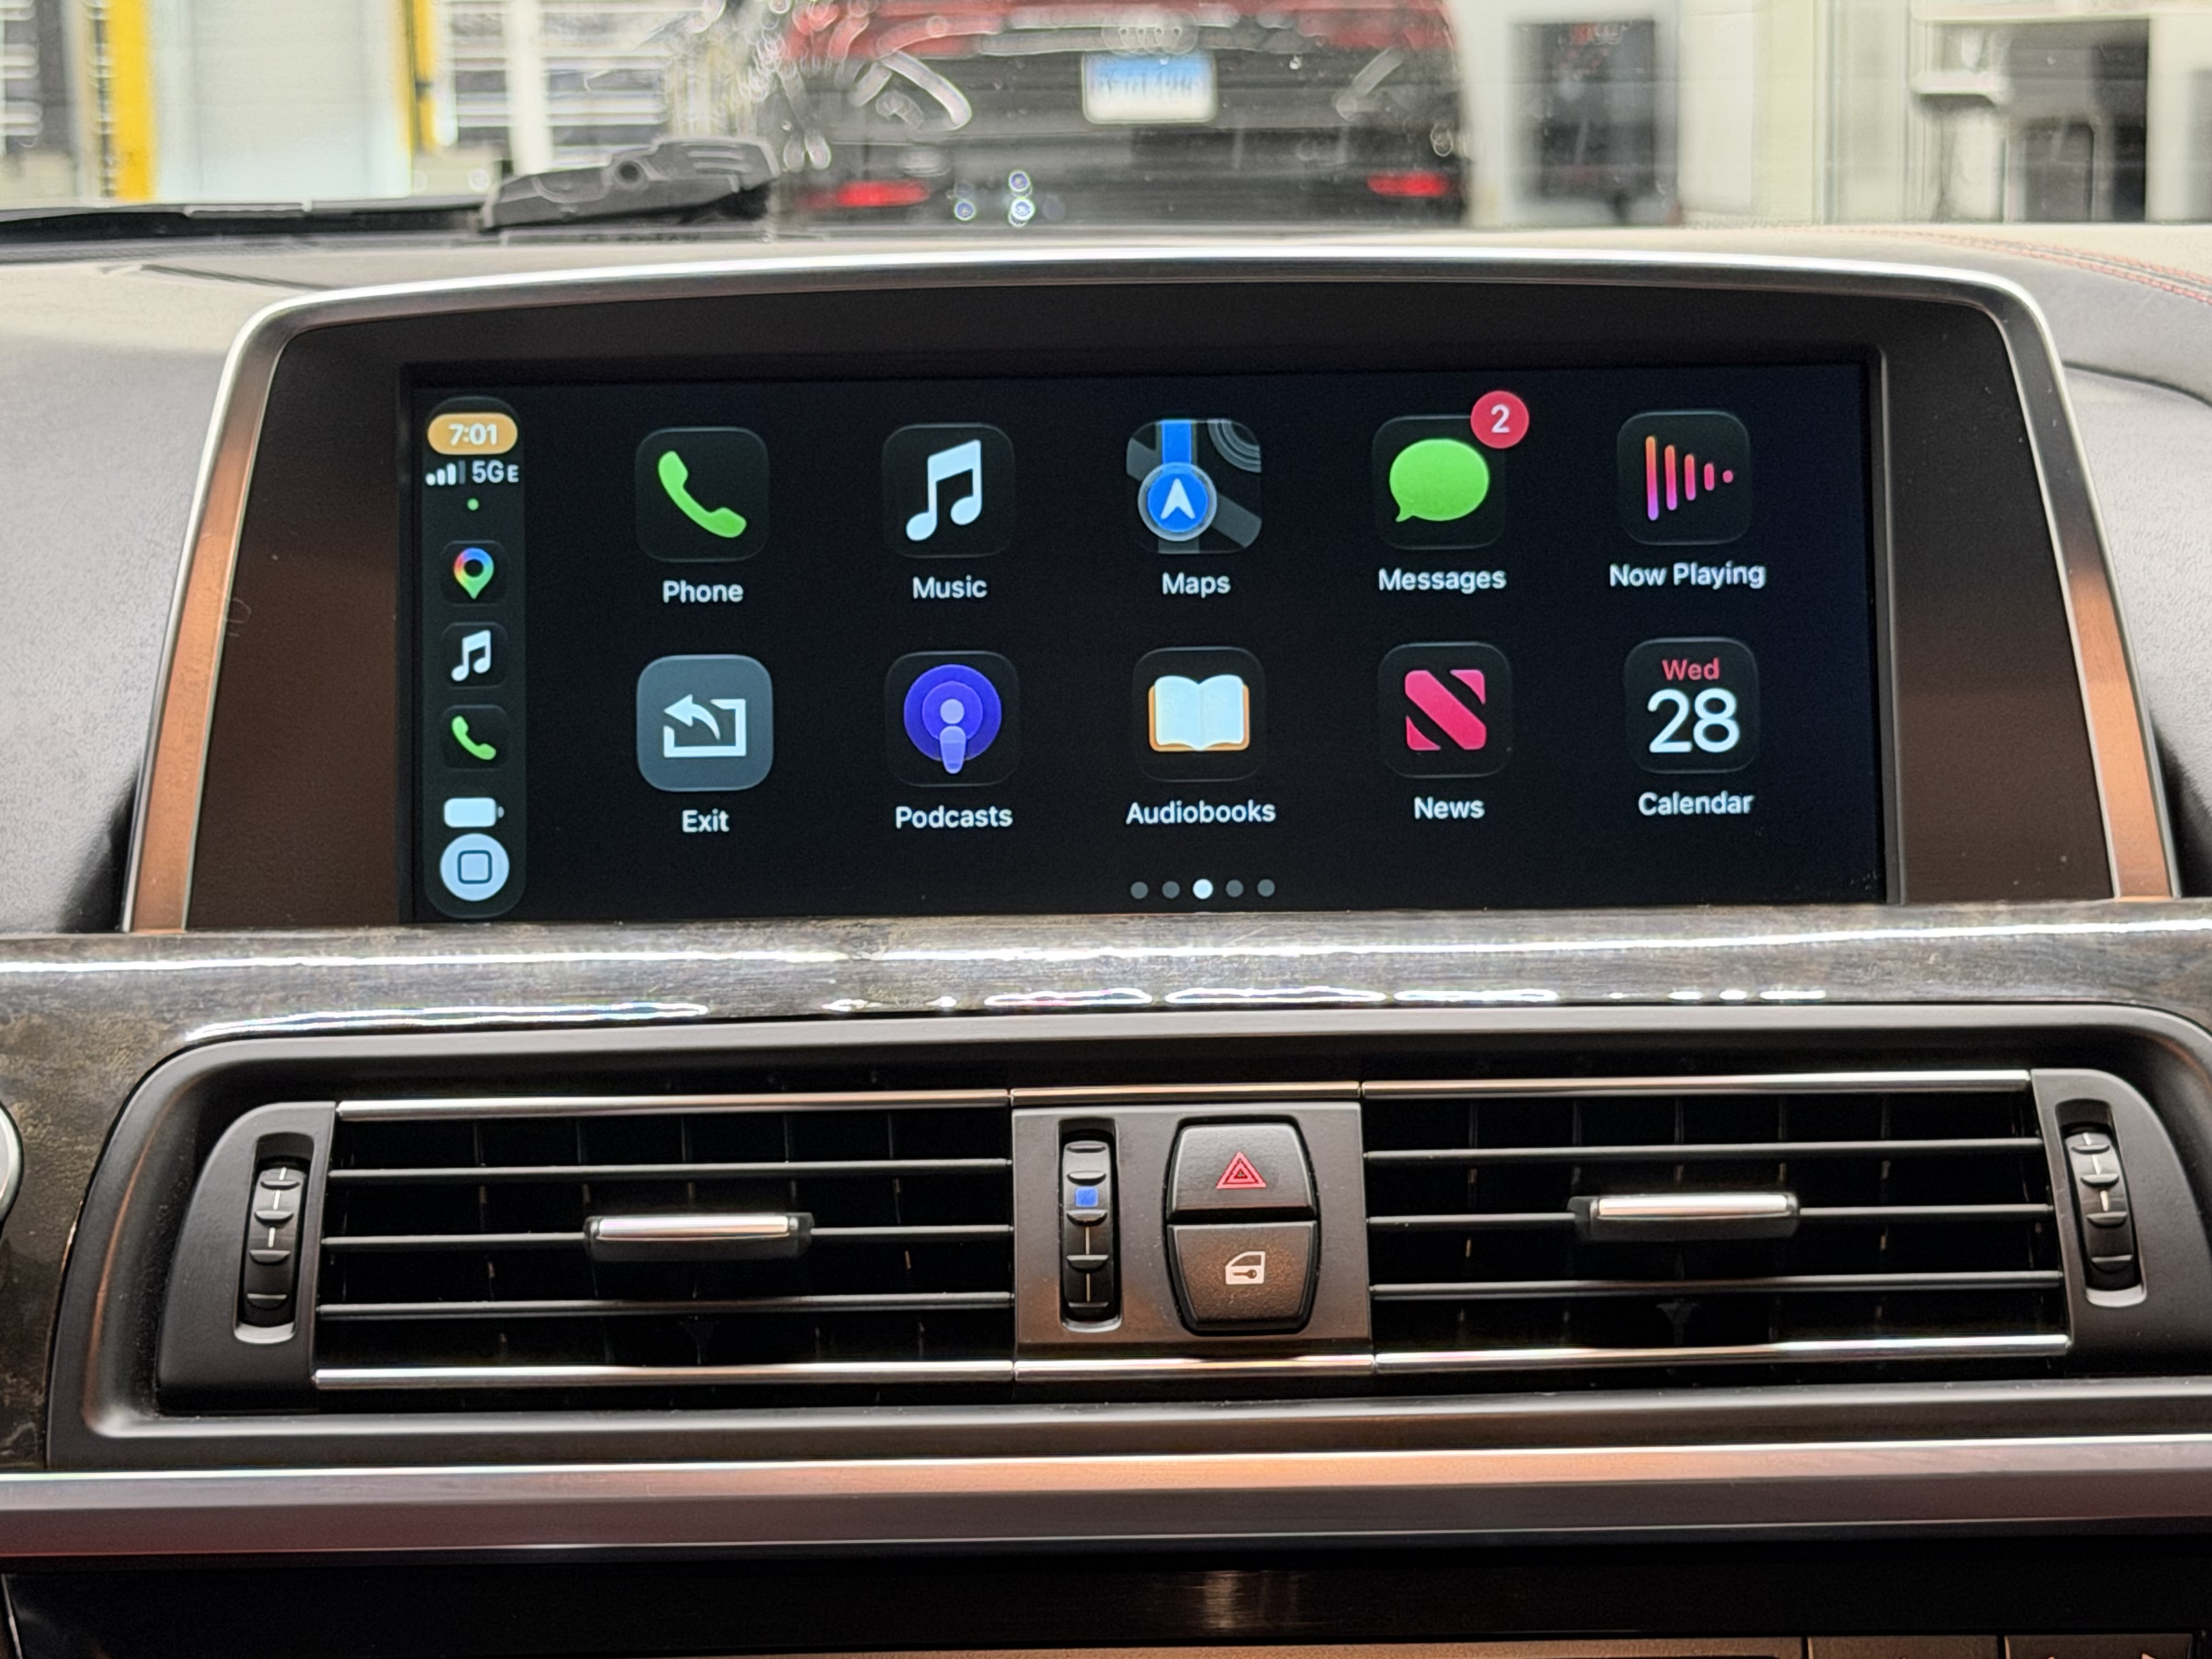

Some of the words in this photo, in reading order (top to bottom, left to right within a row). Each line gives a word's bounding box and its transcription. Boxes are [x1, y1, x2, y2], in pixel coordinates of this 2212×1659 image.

[1491, 404, 1510, 433] 2
[449, 422, 497, 445] 7:01
[913, 575, 987, 599] Music
[1162, 572, 1231, 599] Maps
[1379, 568, 1506, 594] Messages
[1610, 564, 1667, 586] Now
[1673, 561, 1766, 590] Playing
[663, 580, 744, 603] Phone
[1662, 657, 1720, 680] Wed
[1647, 687, 1740, 753] 28
[1126, 799, 1276, 825] Audiobooks
[1414, 797, 1485, 819] News
[1638, 791, 1754, 816] Calendar
[682, 808, 730, 833] Exit
[895, 805, 1013, 829] Podcasts
